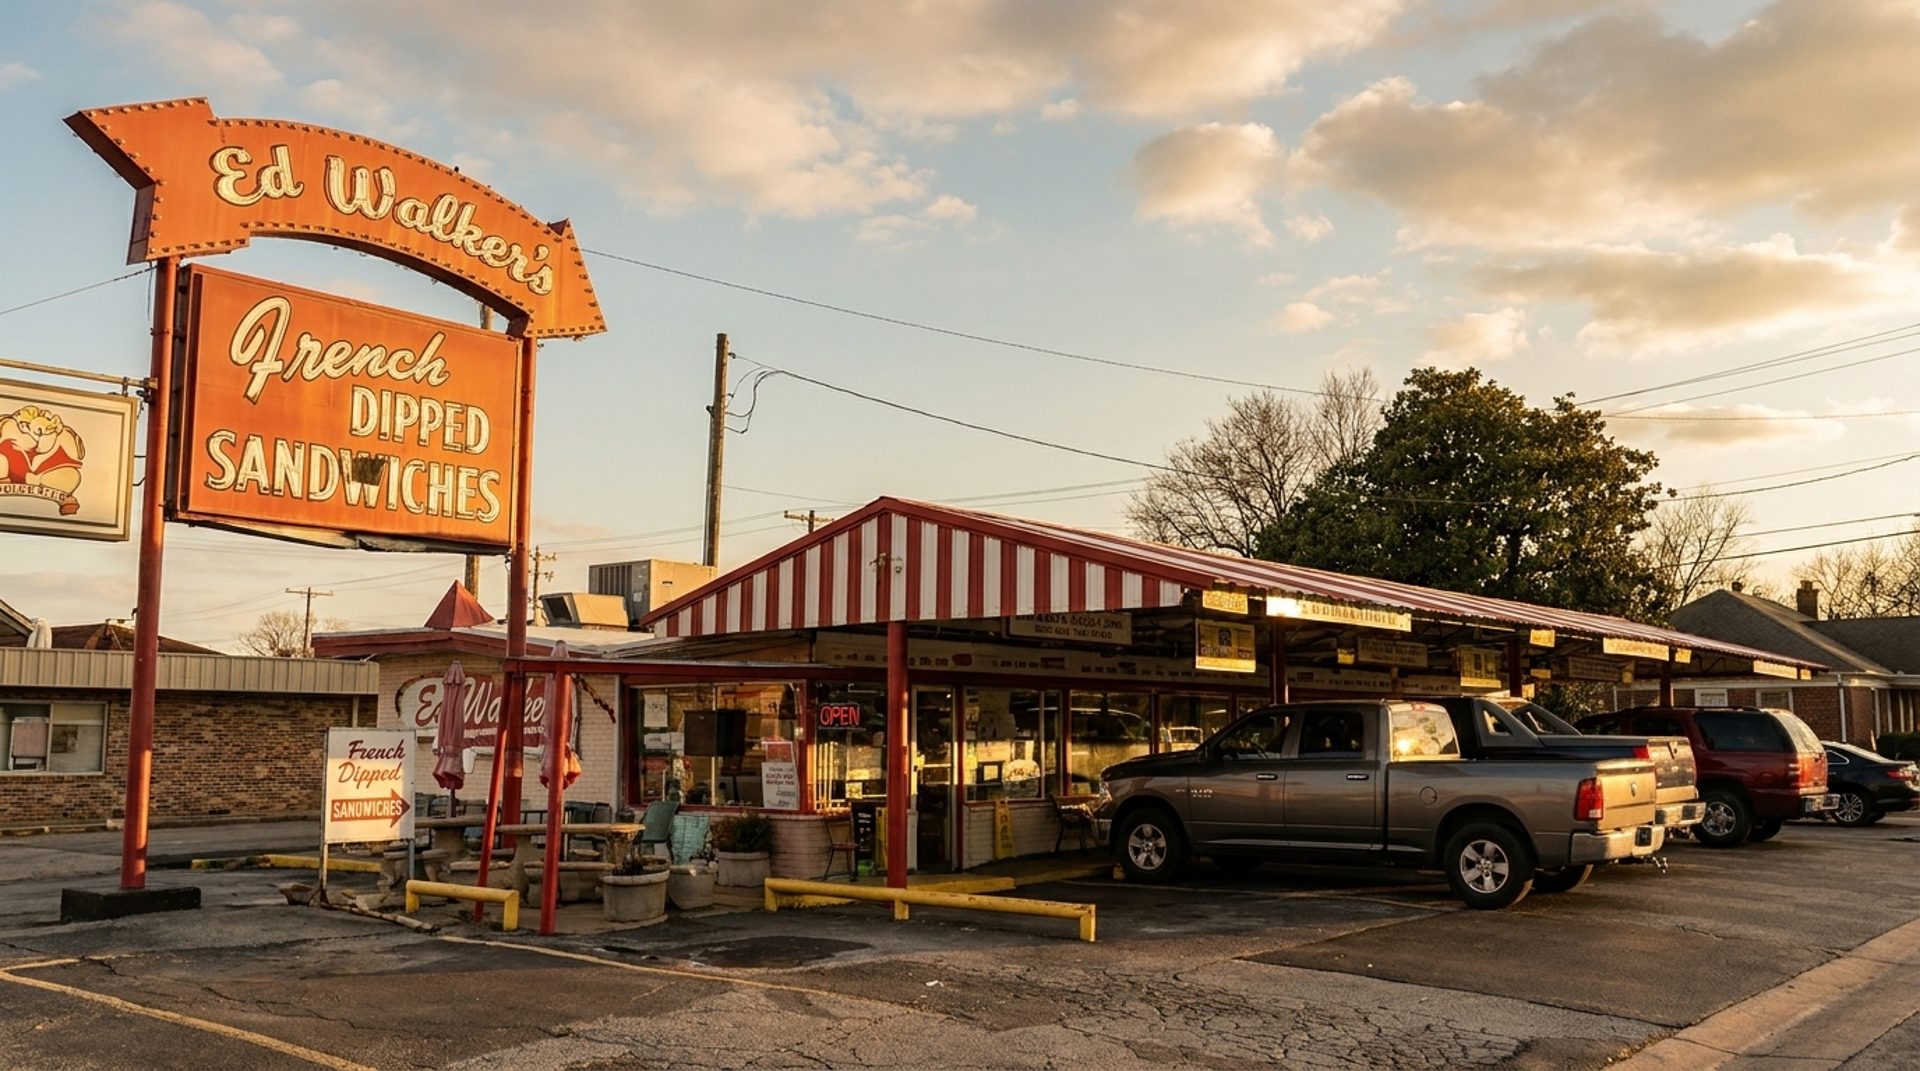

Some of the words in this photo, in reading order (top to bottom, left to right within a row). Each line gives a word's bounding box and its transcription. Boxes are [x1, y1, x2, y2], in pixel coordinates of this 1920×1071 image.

[209, 144, 304, 206] Ed
[324, 154, 555, 296] Walker's
[230, 296, 450, 404] French
[350, 385, 490, 455] DIPPED
[204, 429, 501, 523] SANDWICHES
[415, 684, 443, 727] E
[820, 706, 860, 726] OPEN
[348, 739, 405, 759] French
[338, 761, 402, 789] Dipped
[333, 799, 402, 818] SANDWICHES
